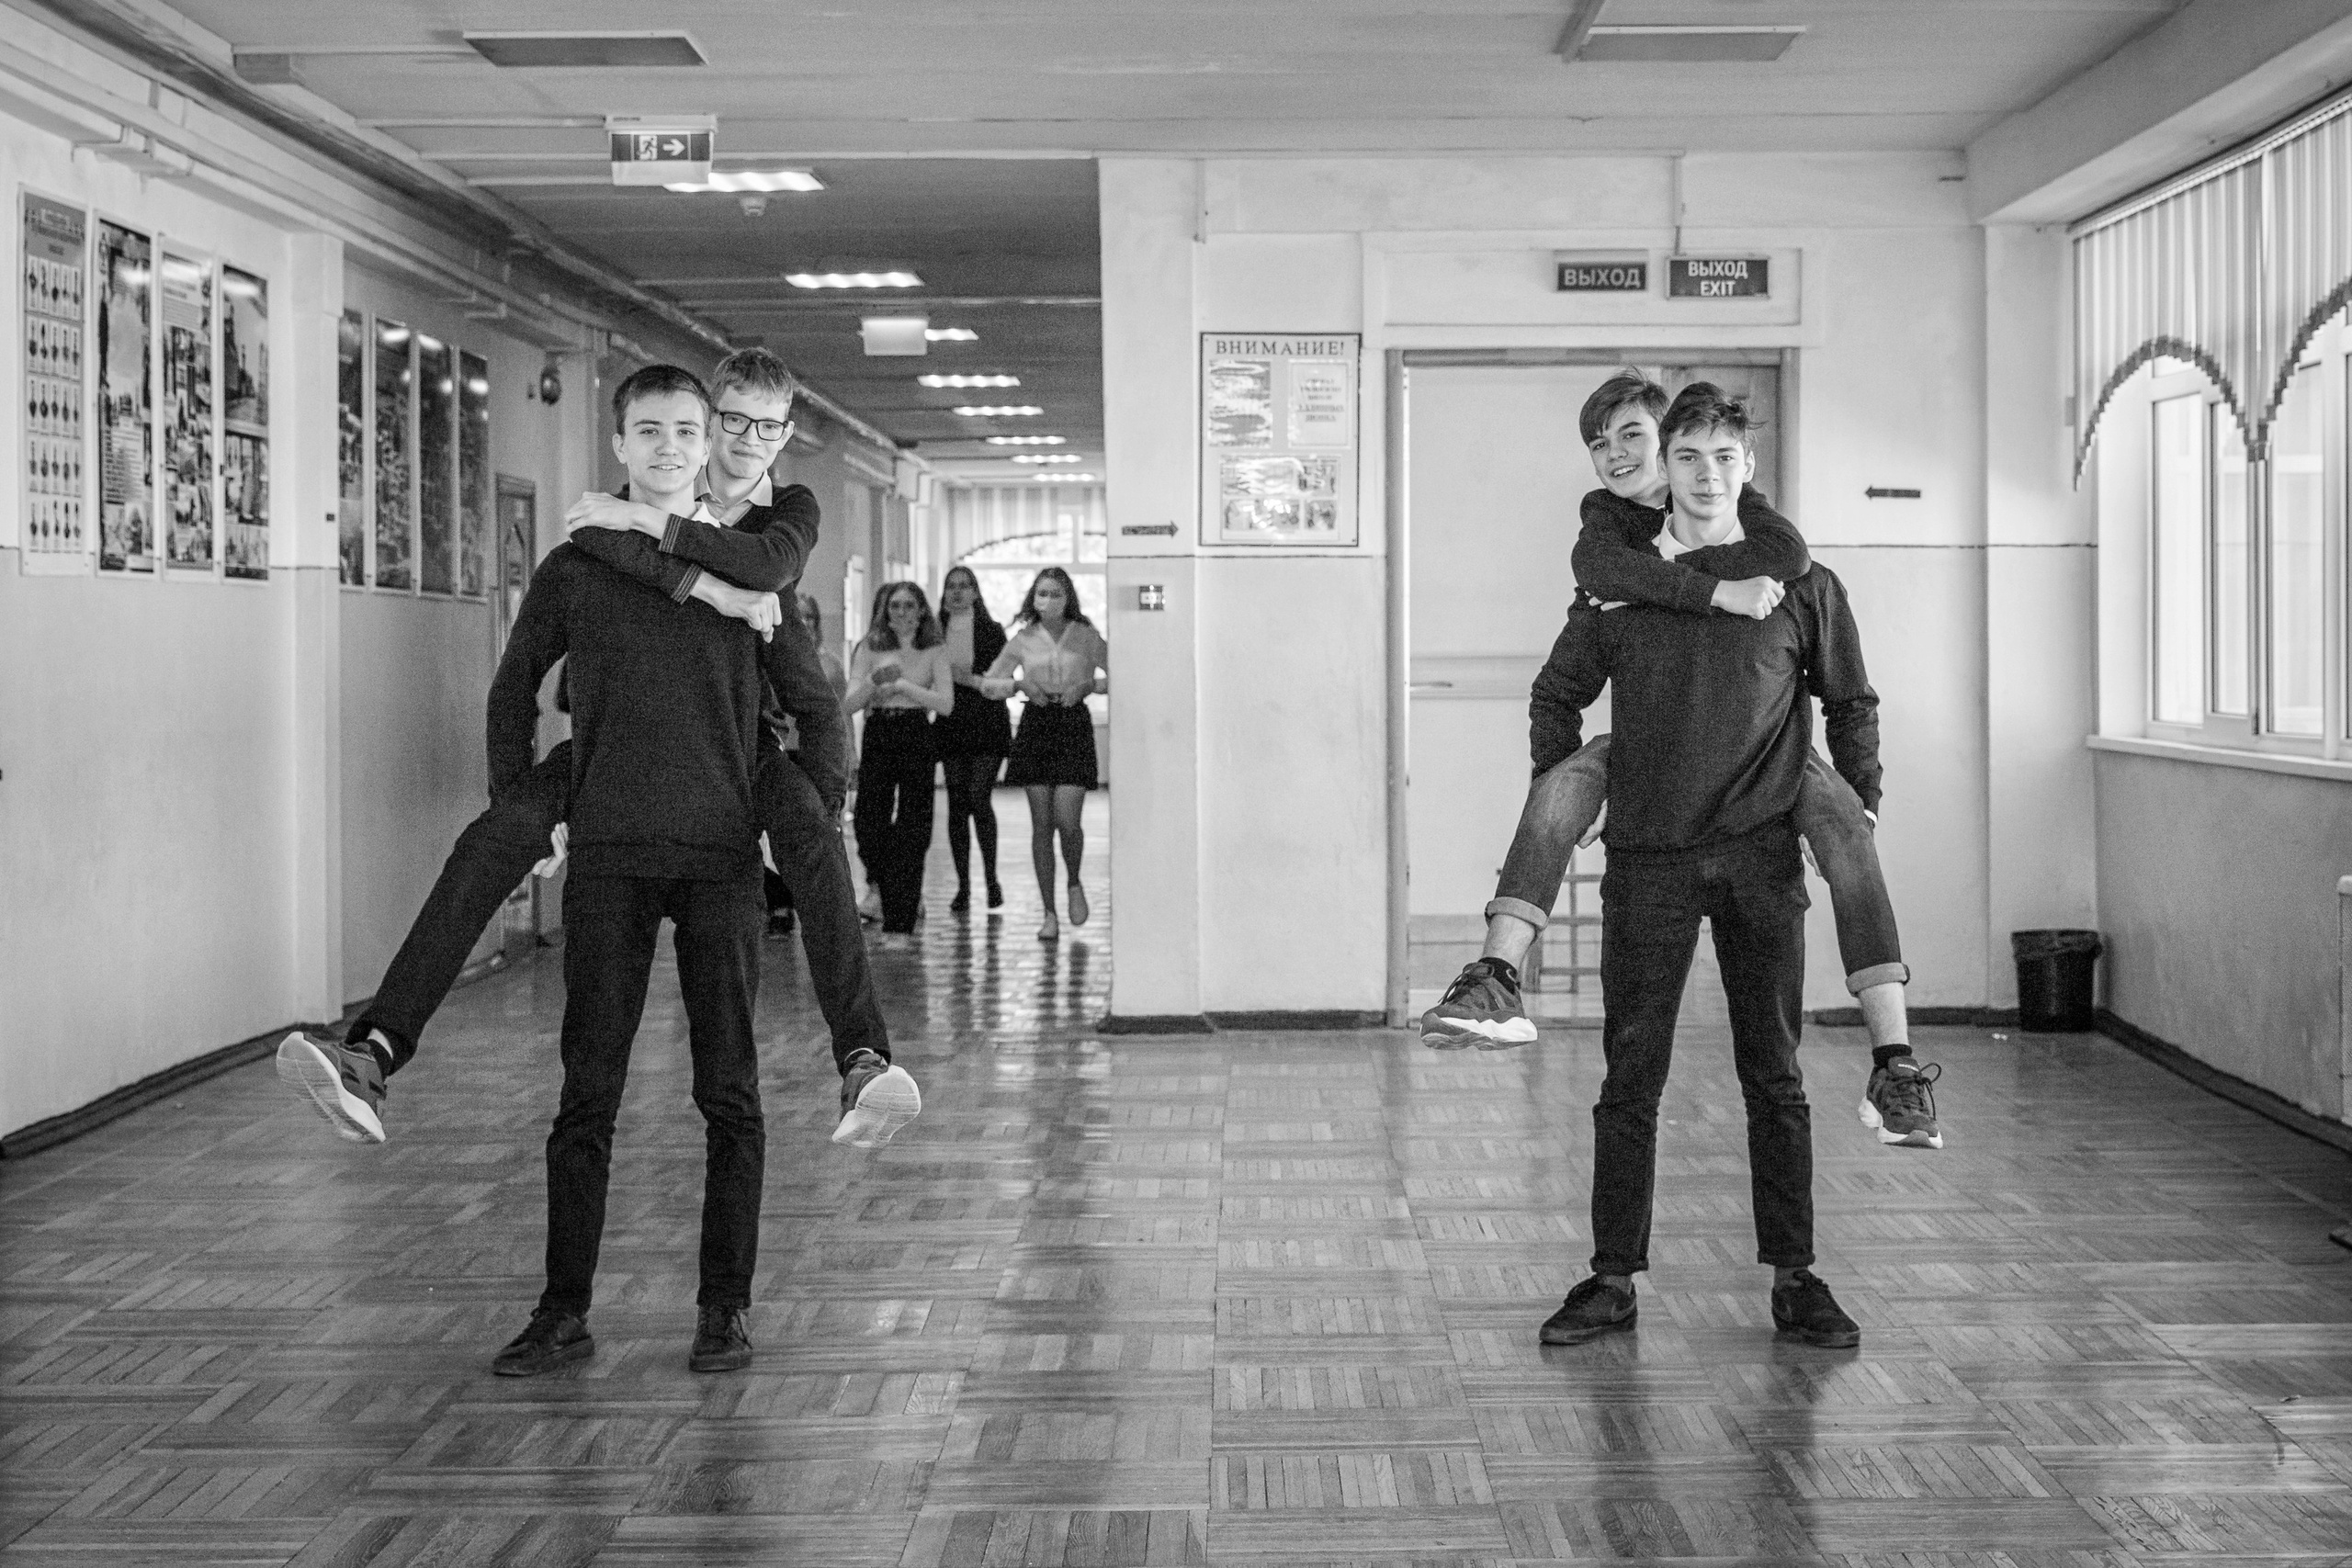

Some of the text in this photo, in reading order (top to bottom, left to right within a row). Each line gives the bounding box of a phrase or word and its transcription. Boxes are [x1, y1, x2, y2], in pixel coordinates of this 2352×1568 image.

[1564, 268, 1641, 288] ВЫХОД
[1688, 261, 1748, 279] ВЫХОД
[1700, 280, 1736, 296] EXIT
[1216, 340, 1344, 355] ВНИМАНИЕ!
